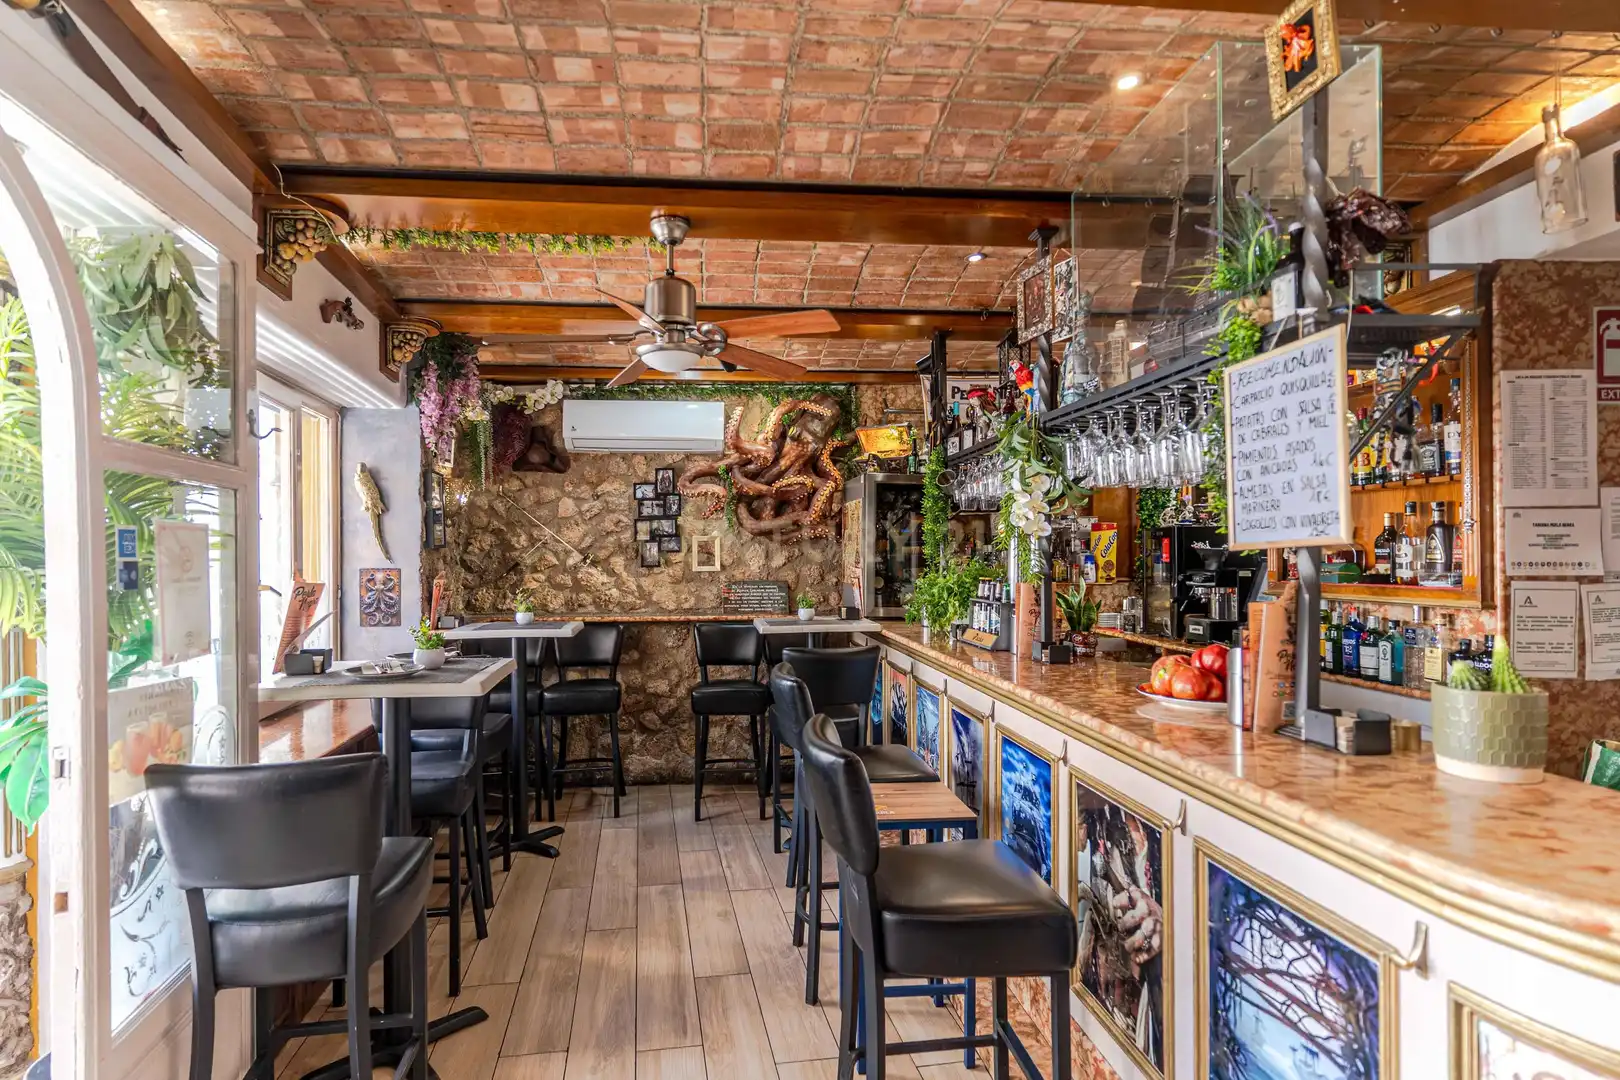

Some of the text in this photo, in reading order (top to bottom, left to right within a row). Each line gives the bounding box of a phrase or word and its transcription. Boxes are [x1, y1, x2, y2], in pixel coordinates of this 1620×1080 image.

[1271, 407, 1288, 422] CON
[1298, 397, 1321, 416] SALSA
[1238, 433, 1246, 445] DE
[1297, 419, 1303, 432] Y
[1309, 414, 1329, 429] MIEL
[1285, 437, 1315, 456] ASADOS
[1236, 469, 1252, 481] CON
[1282, 479, 1293, 494] EN
[1300, 472, 1327, 491] SALSA
[1281, 516, 1296, 529] CON
